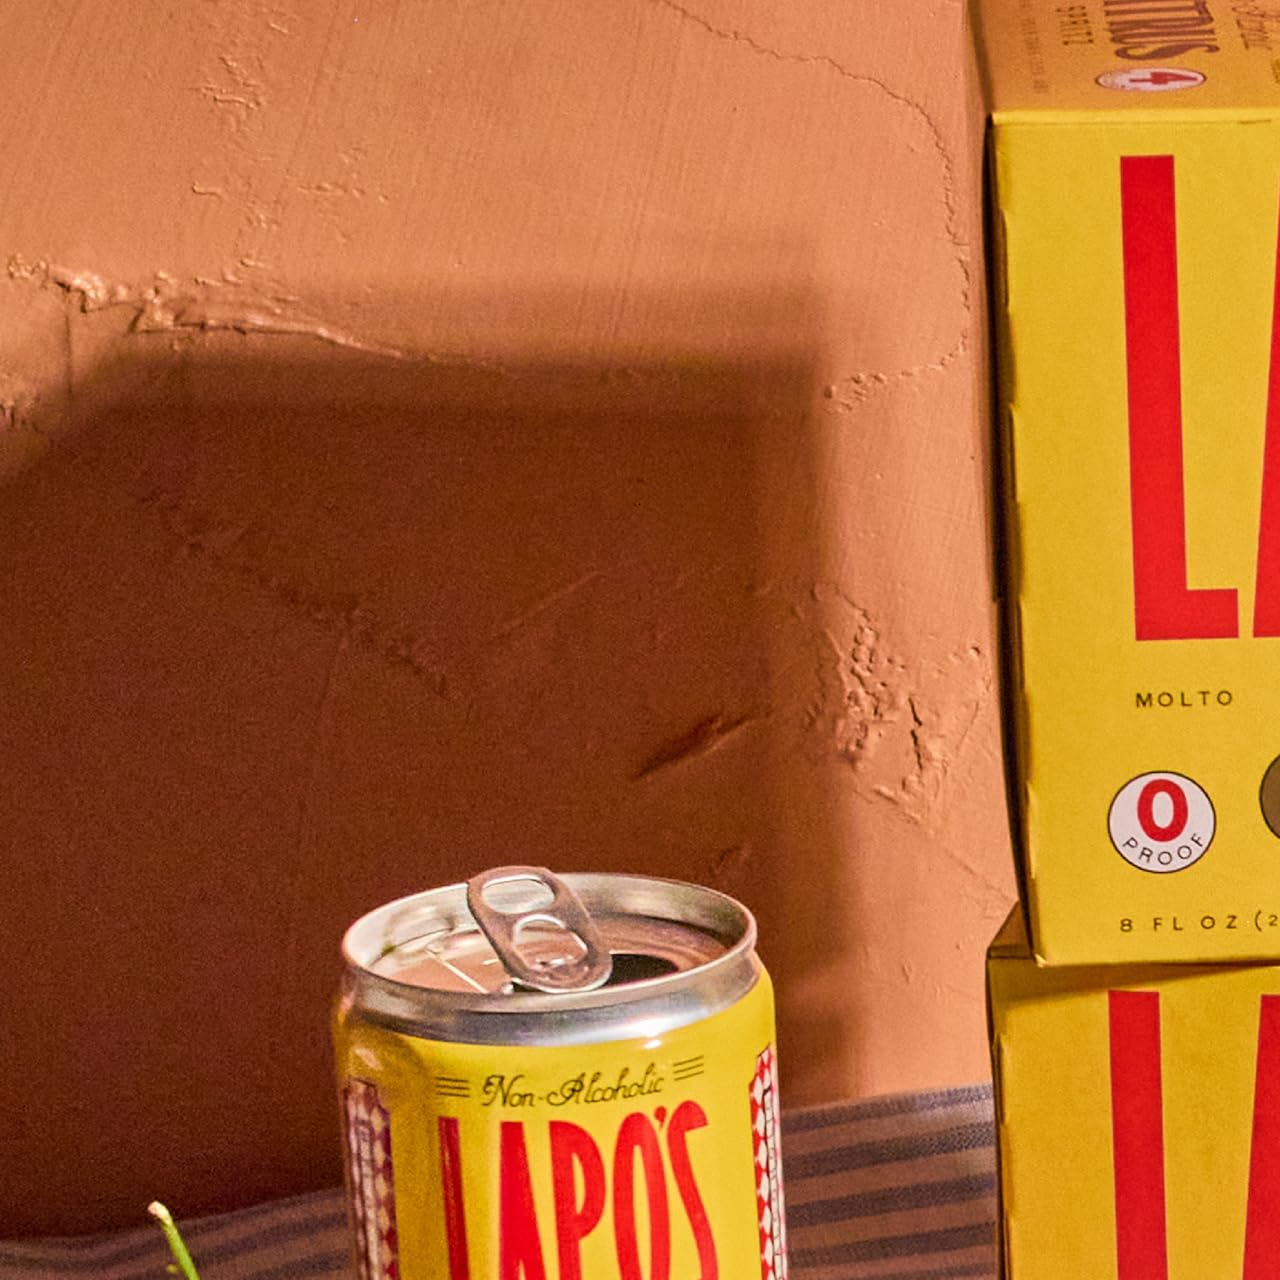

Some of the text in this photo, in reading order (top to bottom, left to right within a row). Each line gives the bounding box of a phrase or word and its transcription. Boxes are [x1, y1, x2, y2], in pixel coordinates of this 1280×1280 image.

[1130, 71, 1198, 85] 4
[1136, 690, 1233, 708] MOLTO
[1137, 779, 1188, 842] 0
[1123, 833, 1204, 866] PROOF
[1119, 919, 1133, 932] 8
[1153, 917, 1183, 931] FL
[1200, 915, 1237, 929] OZ
[482, 1062, 665, 1108] Non-Alcoholic
